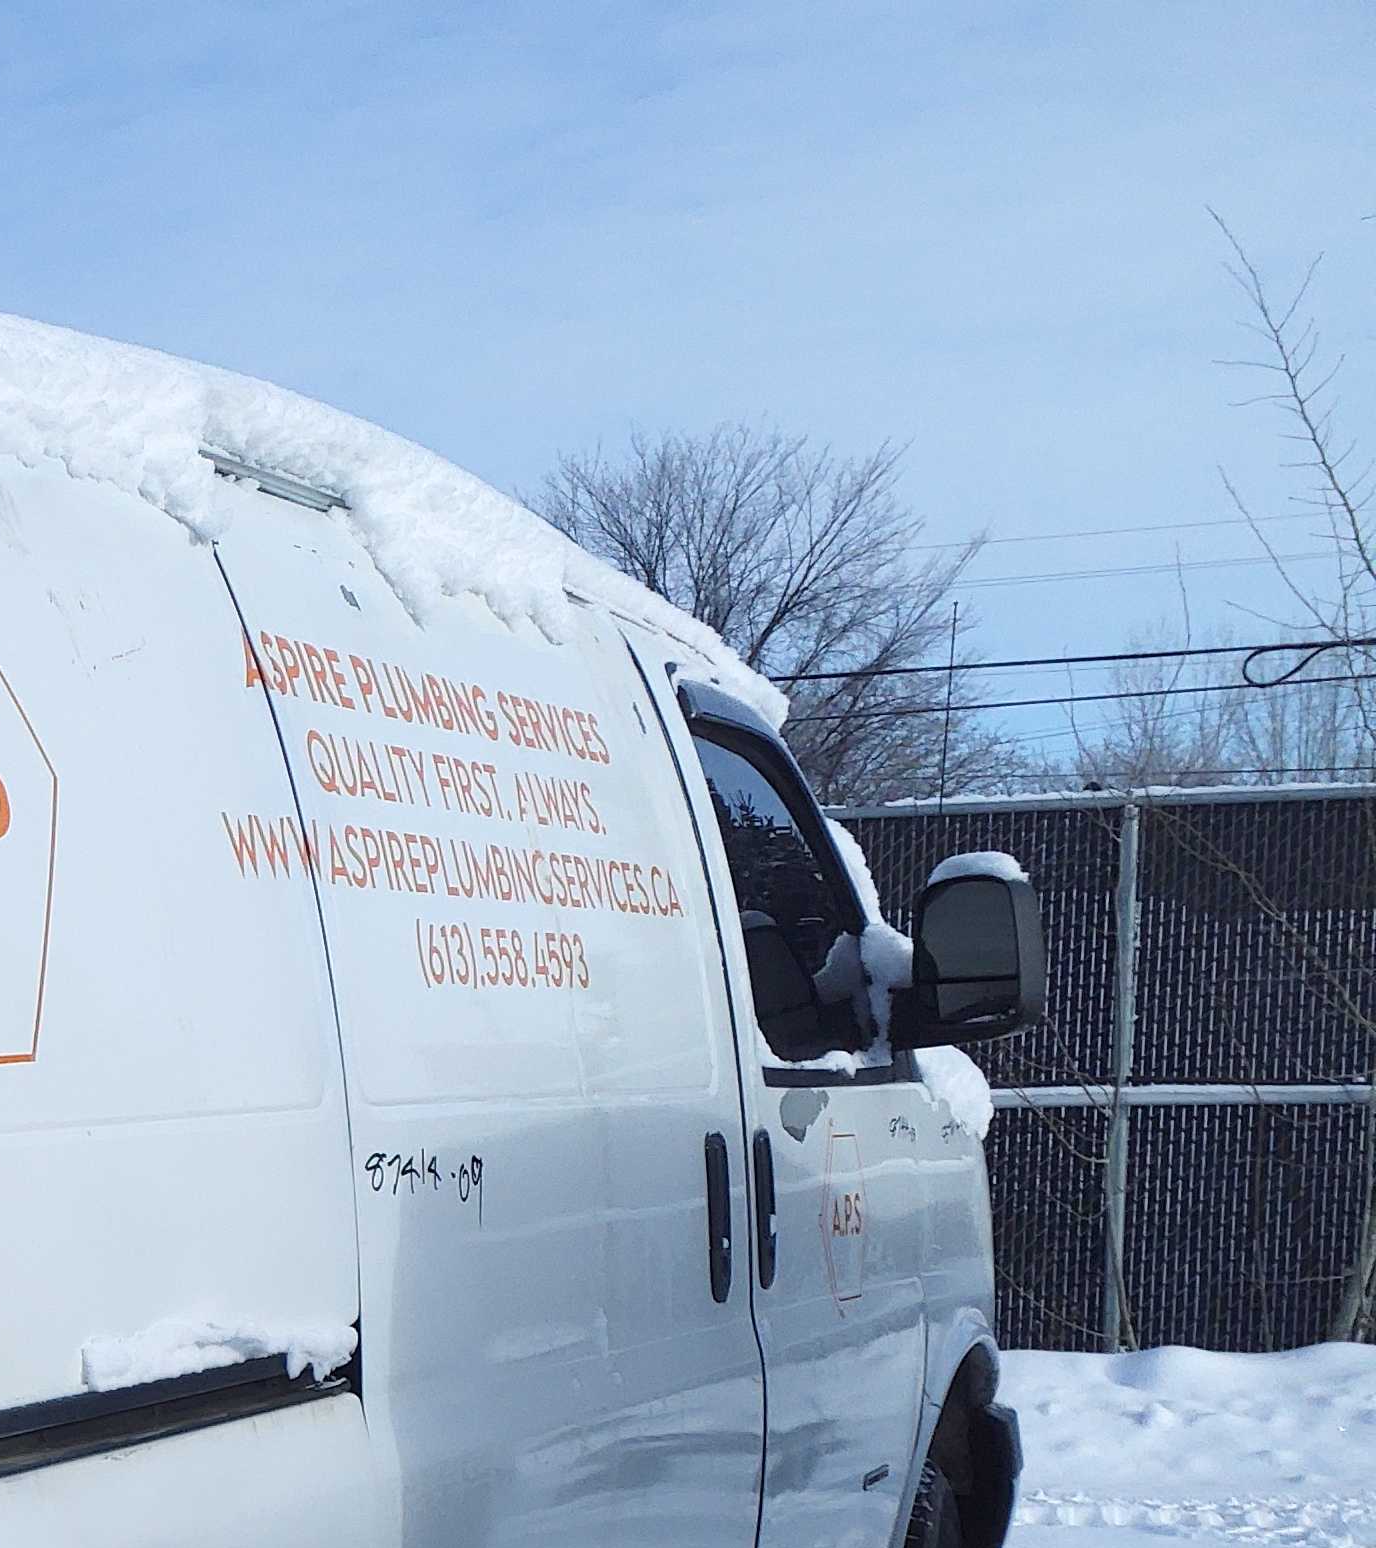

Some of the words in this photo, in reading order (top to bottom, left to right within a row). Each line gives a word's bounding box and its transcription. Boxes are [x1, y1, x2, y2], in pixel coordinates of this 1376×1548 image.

[240, 626, 355, 711] ASPIRE
[349, 655, 498, 741] PLUMBING
[498, 691, 610, 764] SERVICES
[306, 729, 431, 807] QUALITY
[432, 753, 513, 821] FIRST.
[514, 771, 608, 836] ALWAYS.
[416, 918, 590, 989] (613).558.4593
